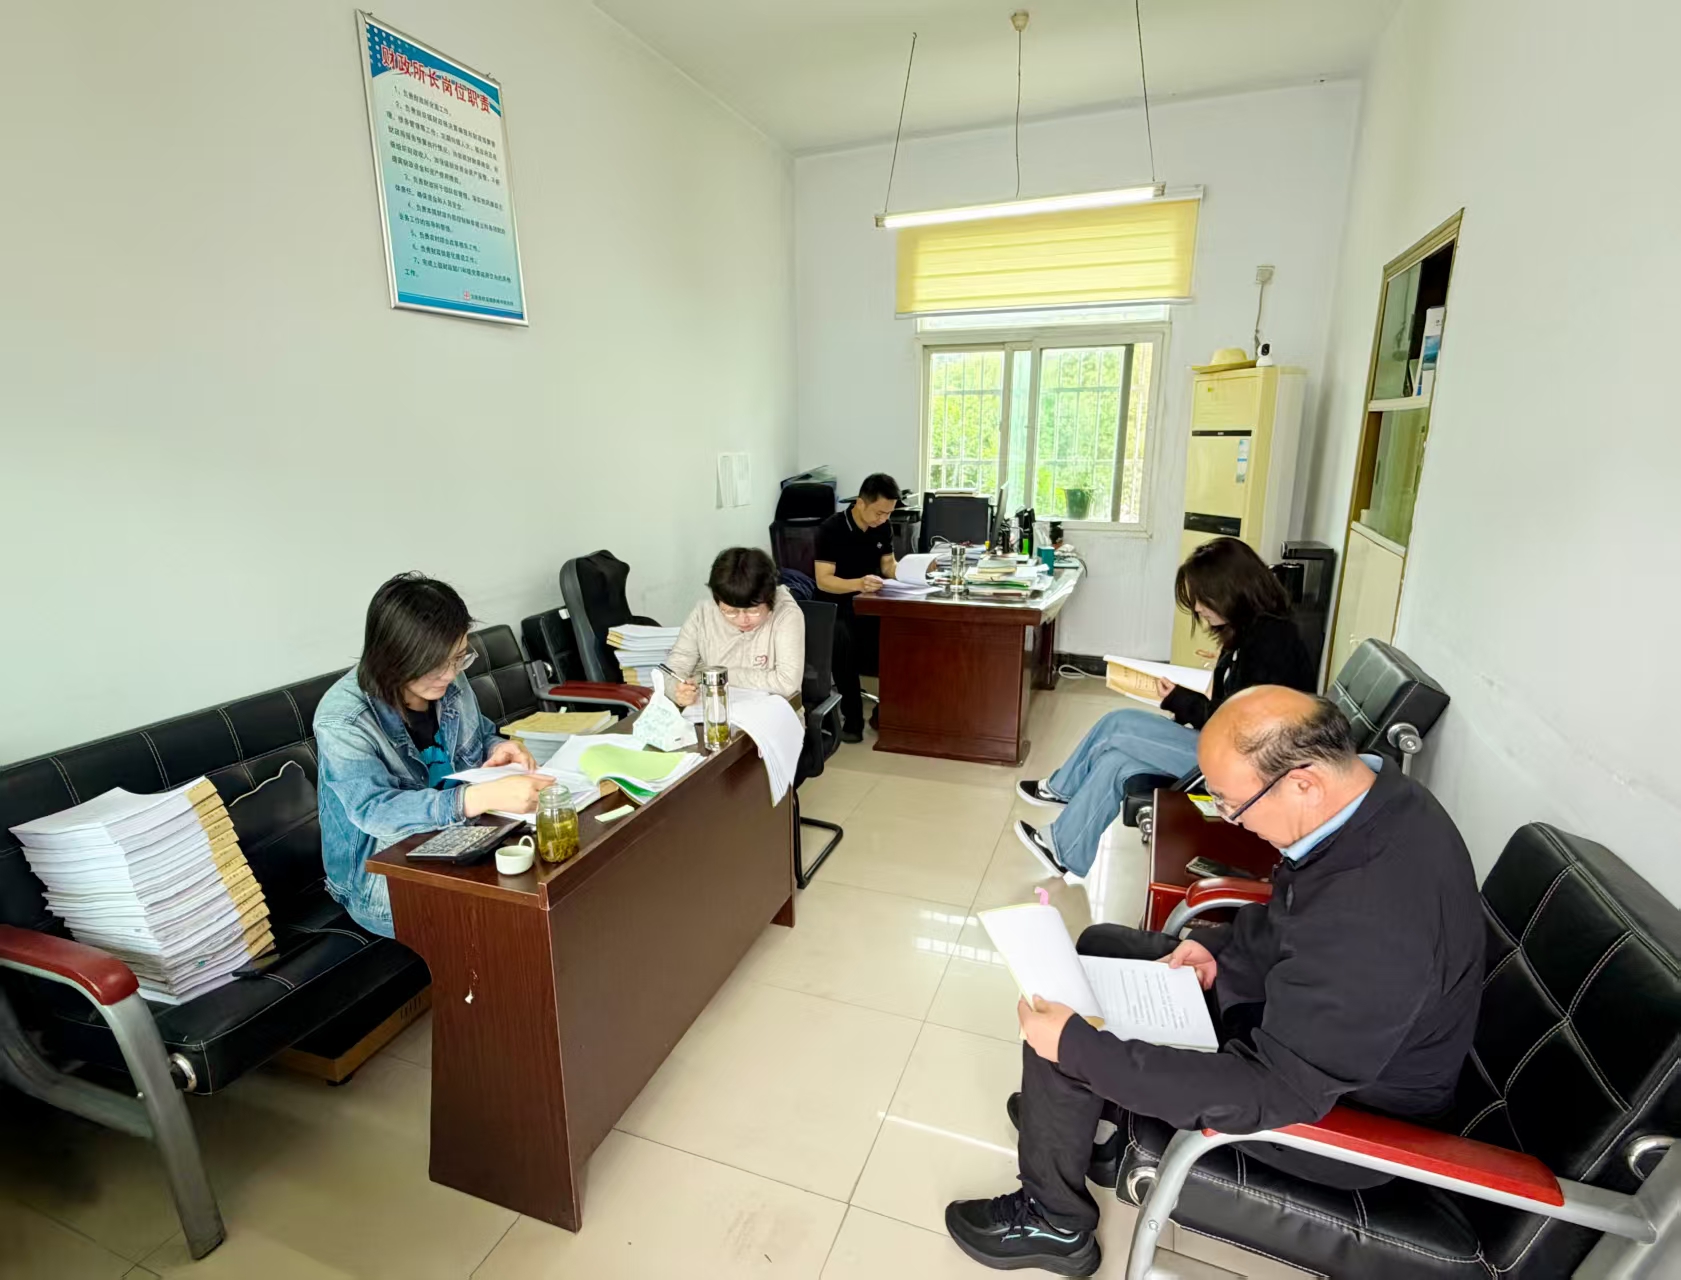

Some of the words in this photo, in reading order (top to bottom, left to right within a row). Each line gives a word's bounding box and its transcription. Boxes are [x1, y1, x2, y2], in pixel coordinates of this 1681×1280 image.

[381, 45, 490, 113] 财政所长岗位职责
